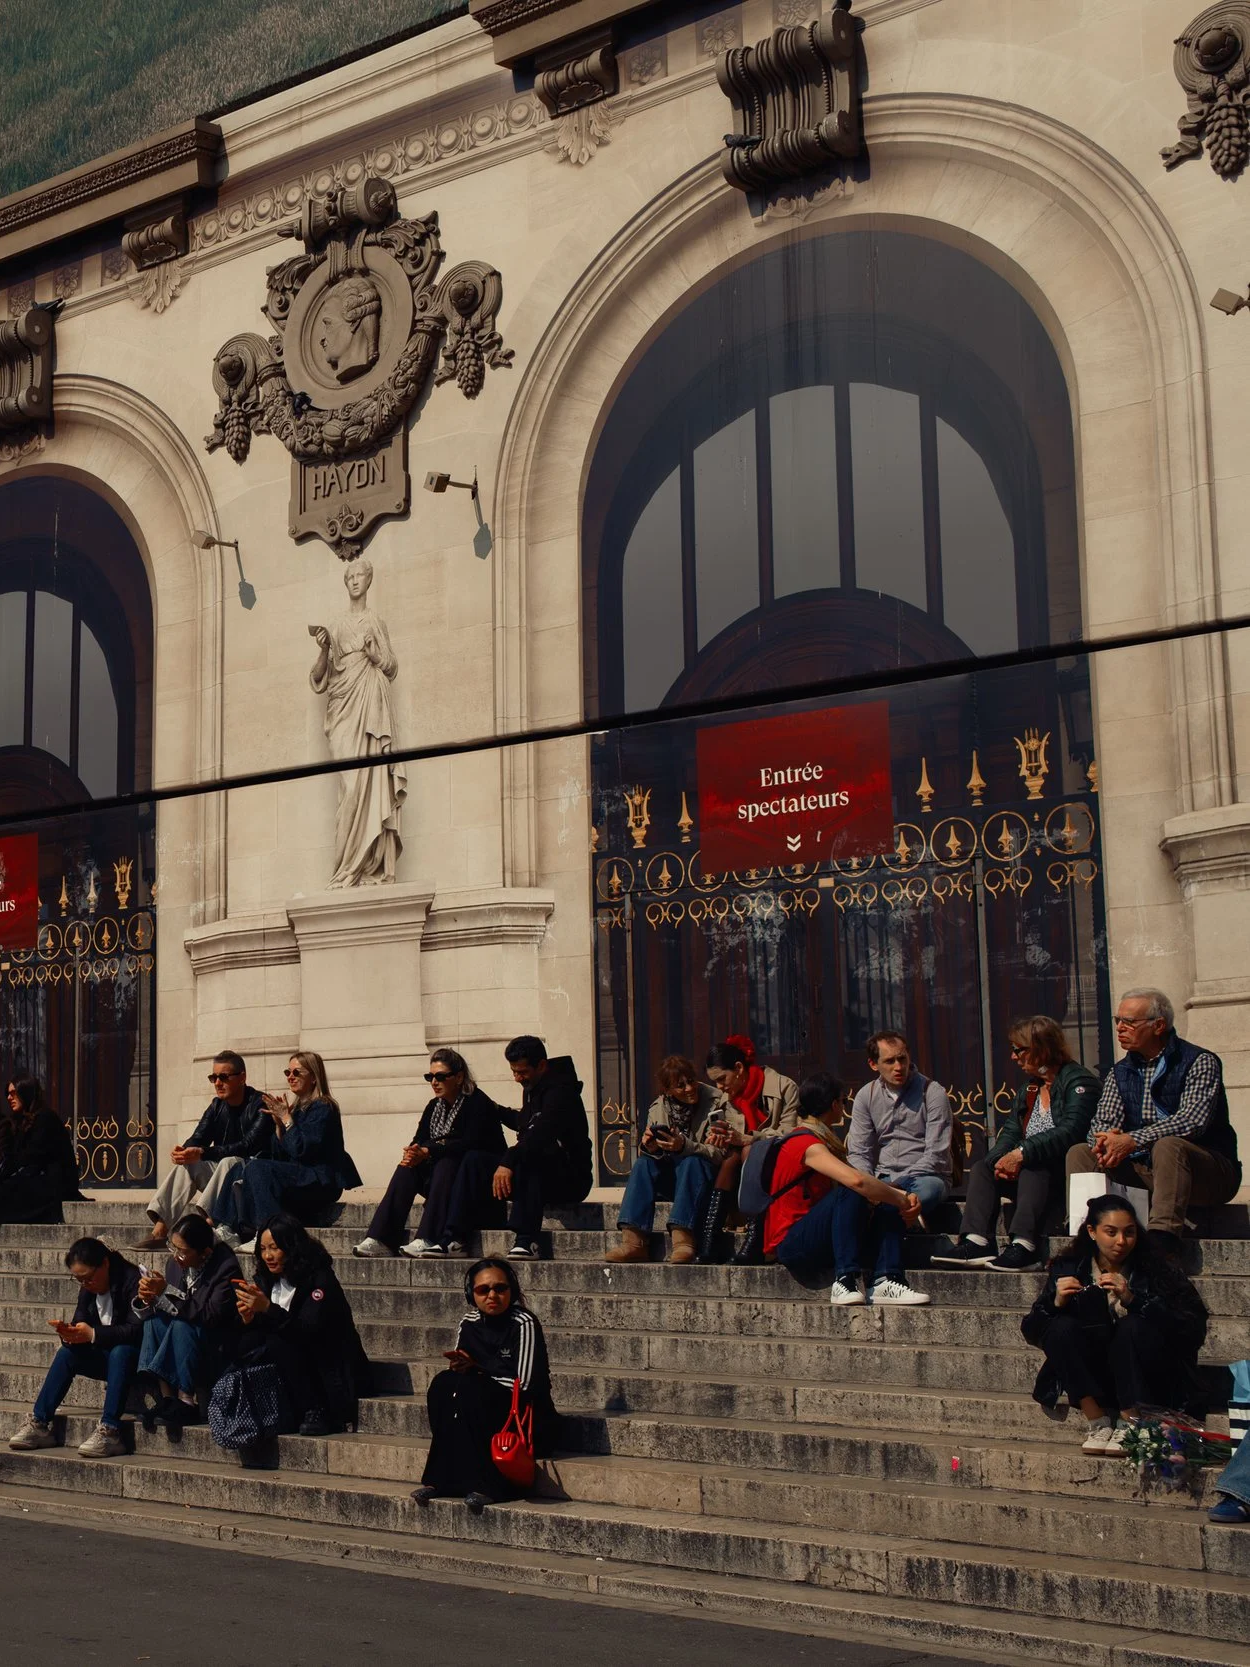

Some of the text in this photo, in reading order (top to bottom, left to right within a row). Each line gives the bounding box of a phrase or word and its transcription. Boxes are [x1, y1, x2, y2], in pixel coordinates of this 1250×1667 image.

[312, 455, 386, 501] HAYDN
[760, 762, 824, 788] Entrée
[738, 790, 850, 823] spectateurs
